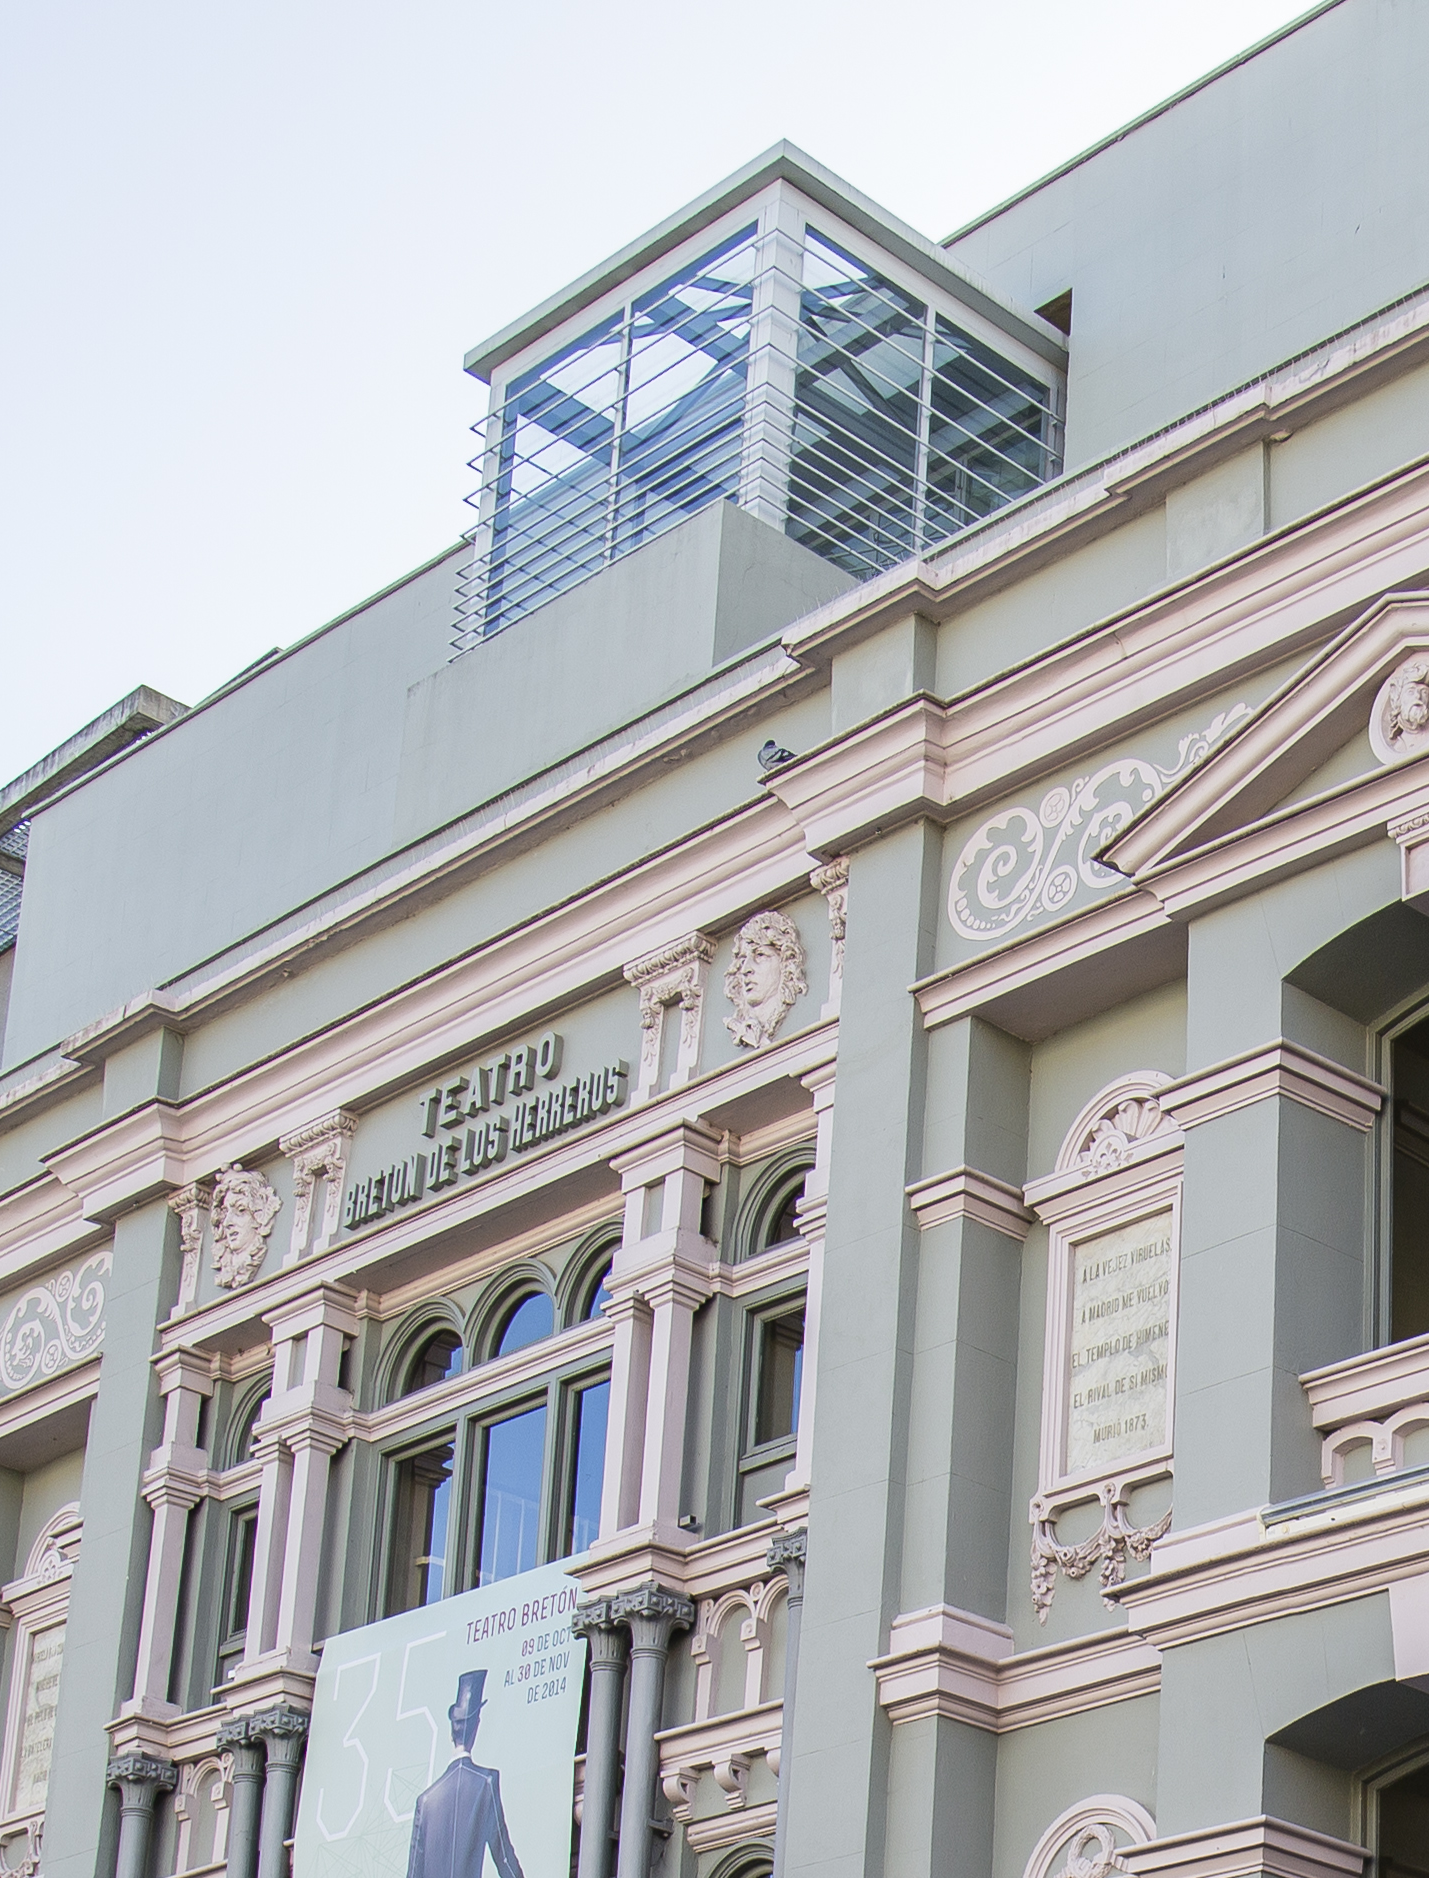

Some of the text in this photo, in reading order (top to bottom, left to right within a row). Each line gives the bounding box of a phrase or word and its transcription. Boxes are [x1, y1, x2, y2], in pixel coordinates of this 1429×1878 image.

[420, 1031, 564, 1139] TEATRO
[343, 1058, 630, 1230] BRETON DE LOS HERREROS
[1082, 1267, 1088, 1284] A
[1089, 1263, 1100, 1281] LA
[1102, 1253, 1128, 1277] VEJEZ
[1081, 1279, 1169, 1325] A MADRID ME VUELVO
[1072, 1320, 1169, 1368] EL TEMPLO DE HIMENE
[1073, 1392, 1084, 1409] EL
[1087, 1383, 1112, 1405] RIVAL
[1114, 1377, 1126, 1395] DE
[466, 1585, 578, 1645] TEATRO BRETÓN
[521, 1625, 572, 1657] 09 DE OCT
[504, 1650, 570, 1688] AL 30 DE NOV
[527, 1676, 567, 1704] DE 2014
